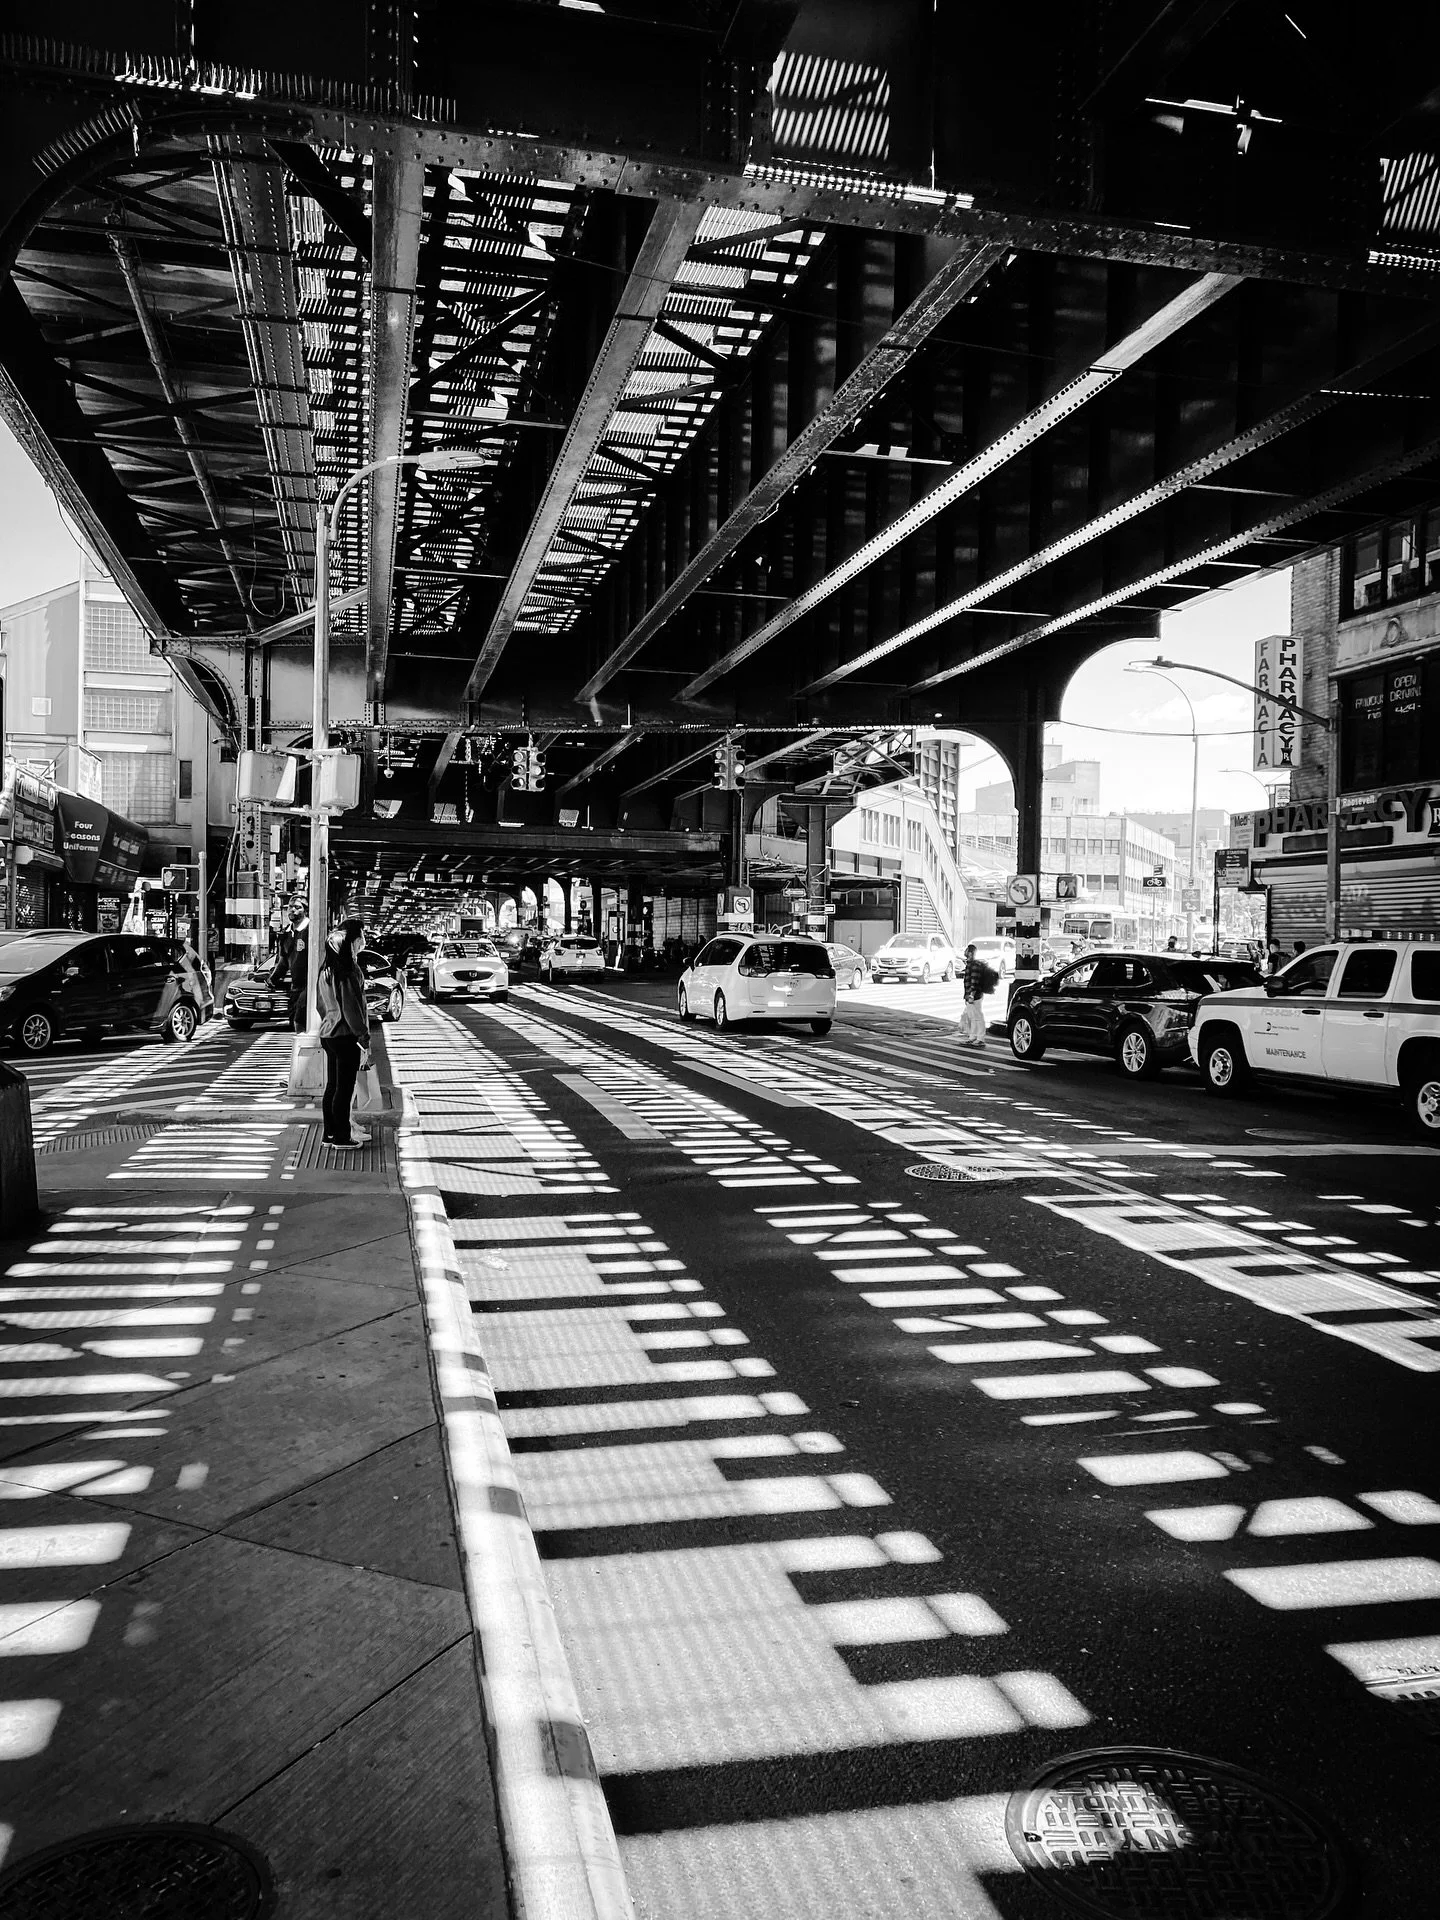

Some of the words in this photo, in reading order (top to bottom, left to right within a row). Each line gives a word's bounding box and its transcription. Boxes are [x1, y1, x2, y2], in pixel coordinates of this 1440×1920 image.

[1257, 641, 1270, 767] FARMACIA
[1277, 639, 1297, 748] PHARMACY
[74, 820, 94, 830] Four
[1254, 787, 1432, 848] PHARCY
[63, 841, 99, 852] Uniforms
[1265, 1047, 1307, 1059] MAINTENANCE
